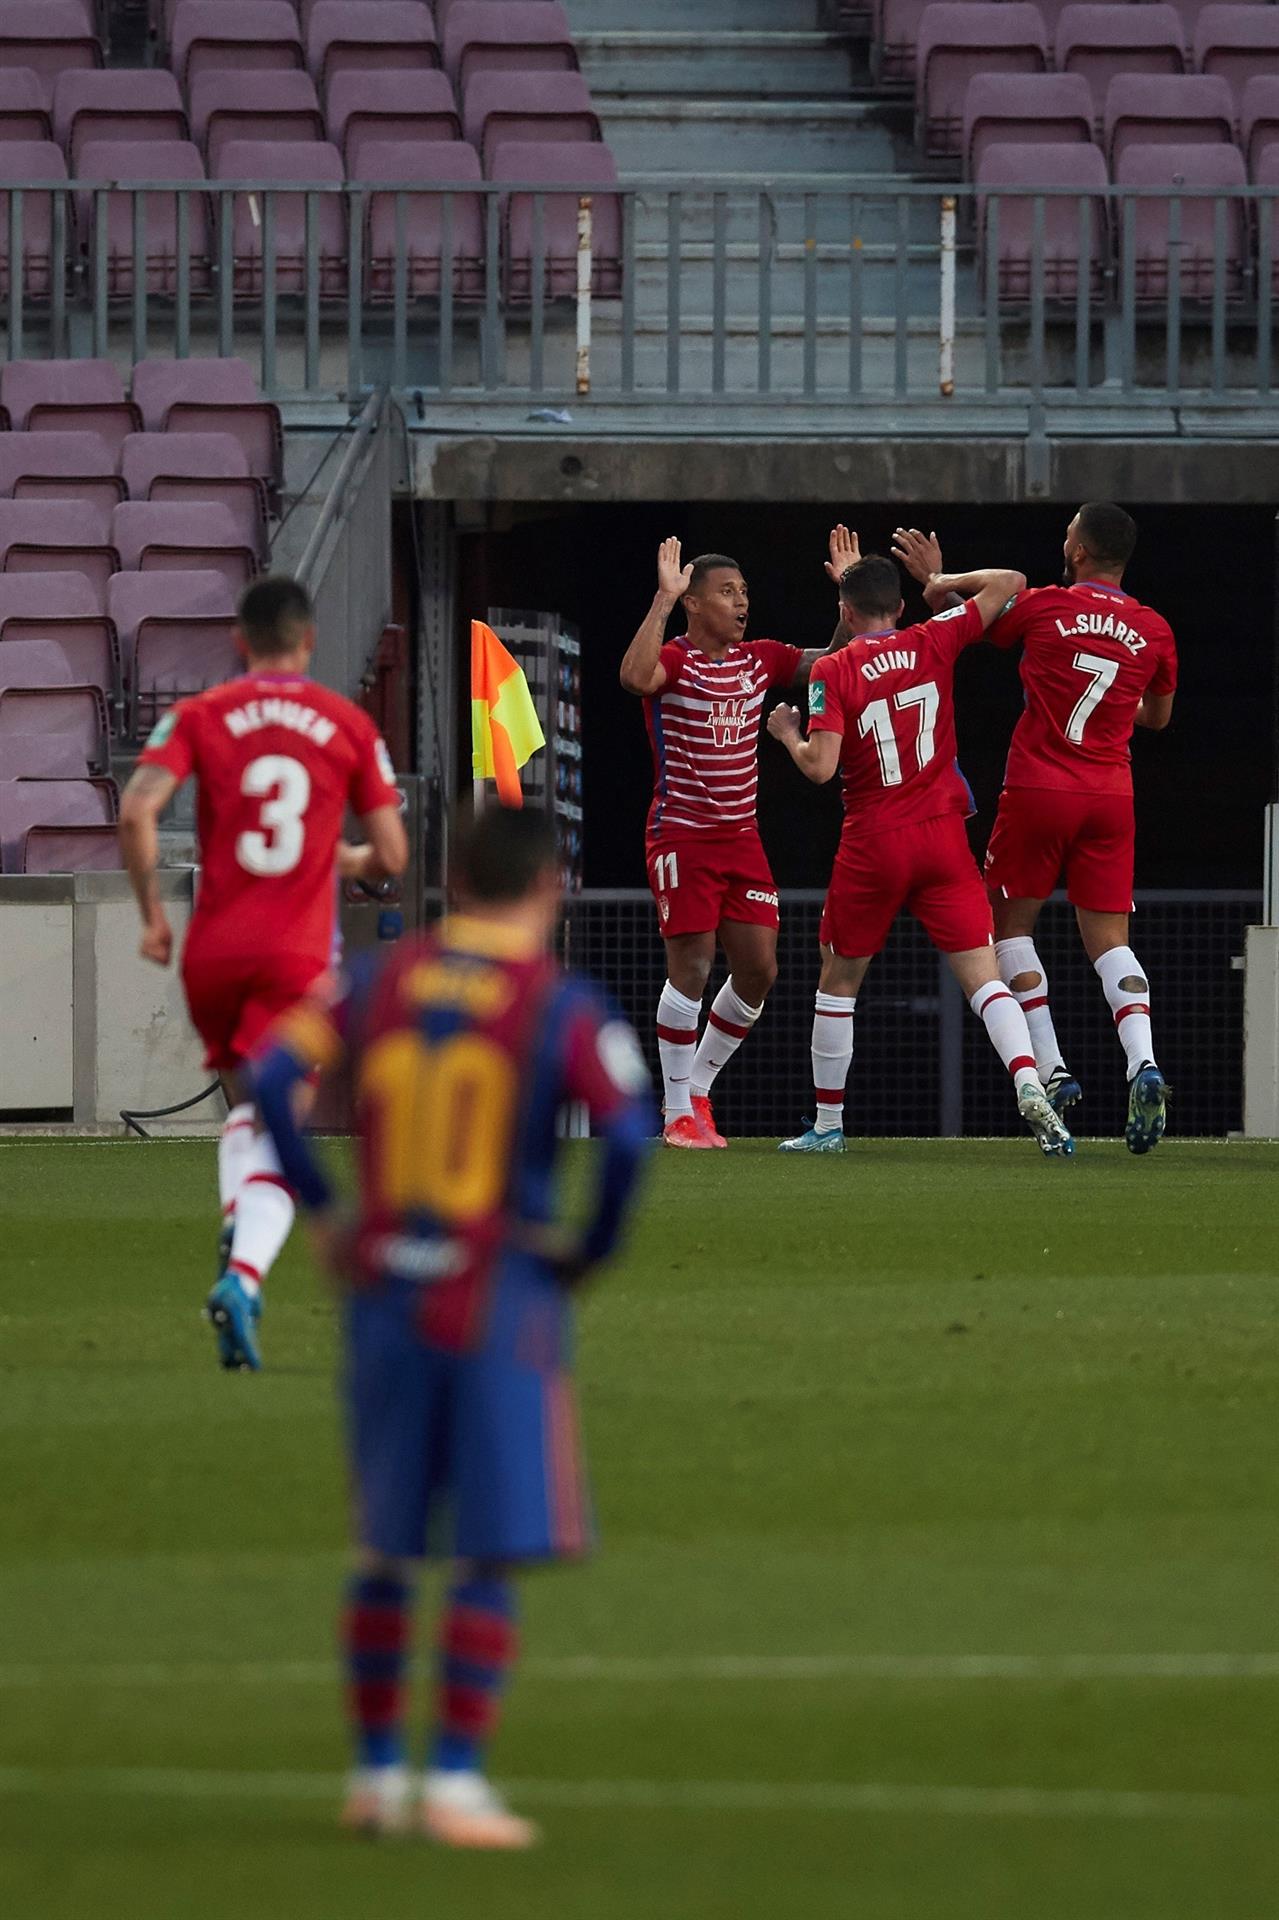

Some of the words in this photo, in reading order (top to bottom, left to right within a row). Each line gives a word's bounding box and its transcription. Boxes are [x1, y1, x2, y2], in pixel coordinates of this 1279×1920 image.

[860, 650, 916, 681] QUINI
[1055, 613, 1147, 656] L.SUÁREZ
[857, 681, 940, 787] 17
[1065, 652, 1119, 745] 7
[235, 754, 312, 877] 3
[655, 851, 679, 892] 11
[362, 1030, 518, 1222] 10
